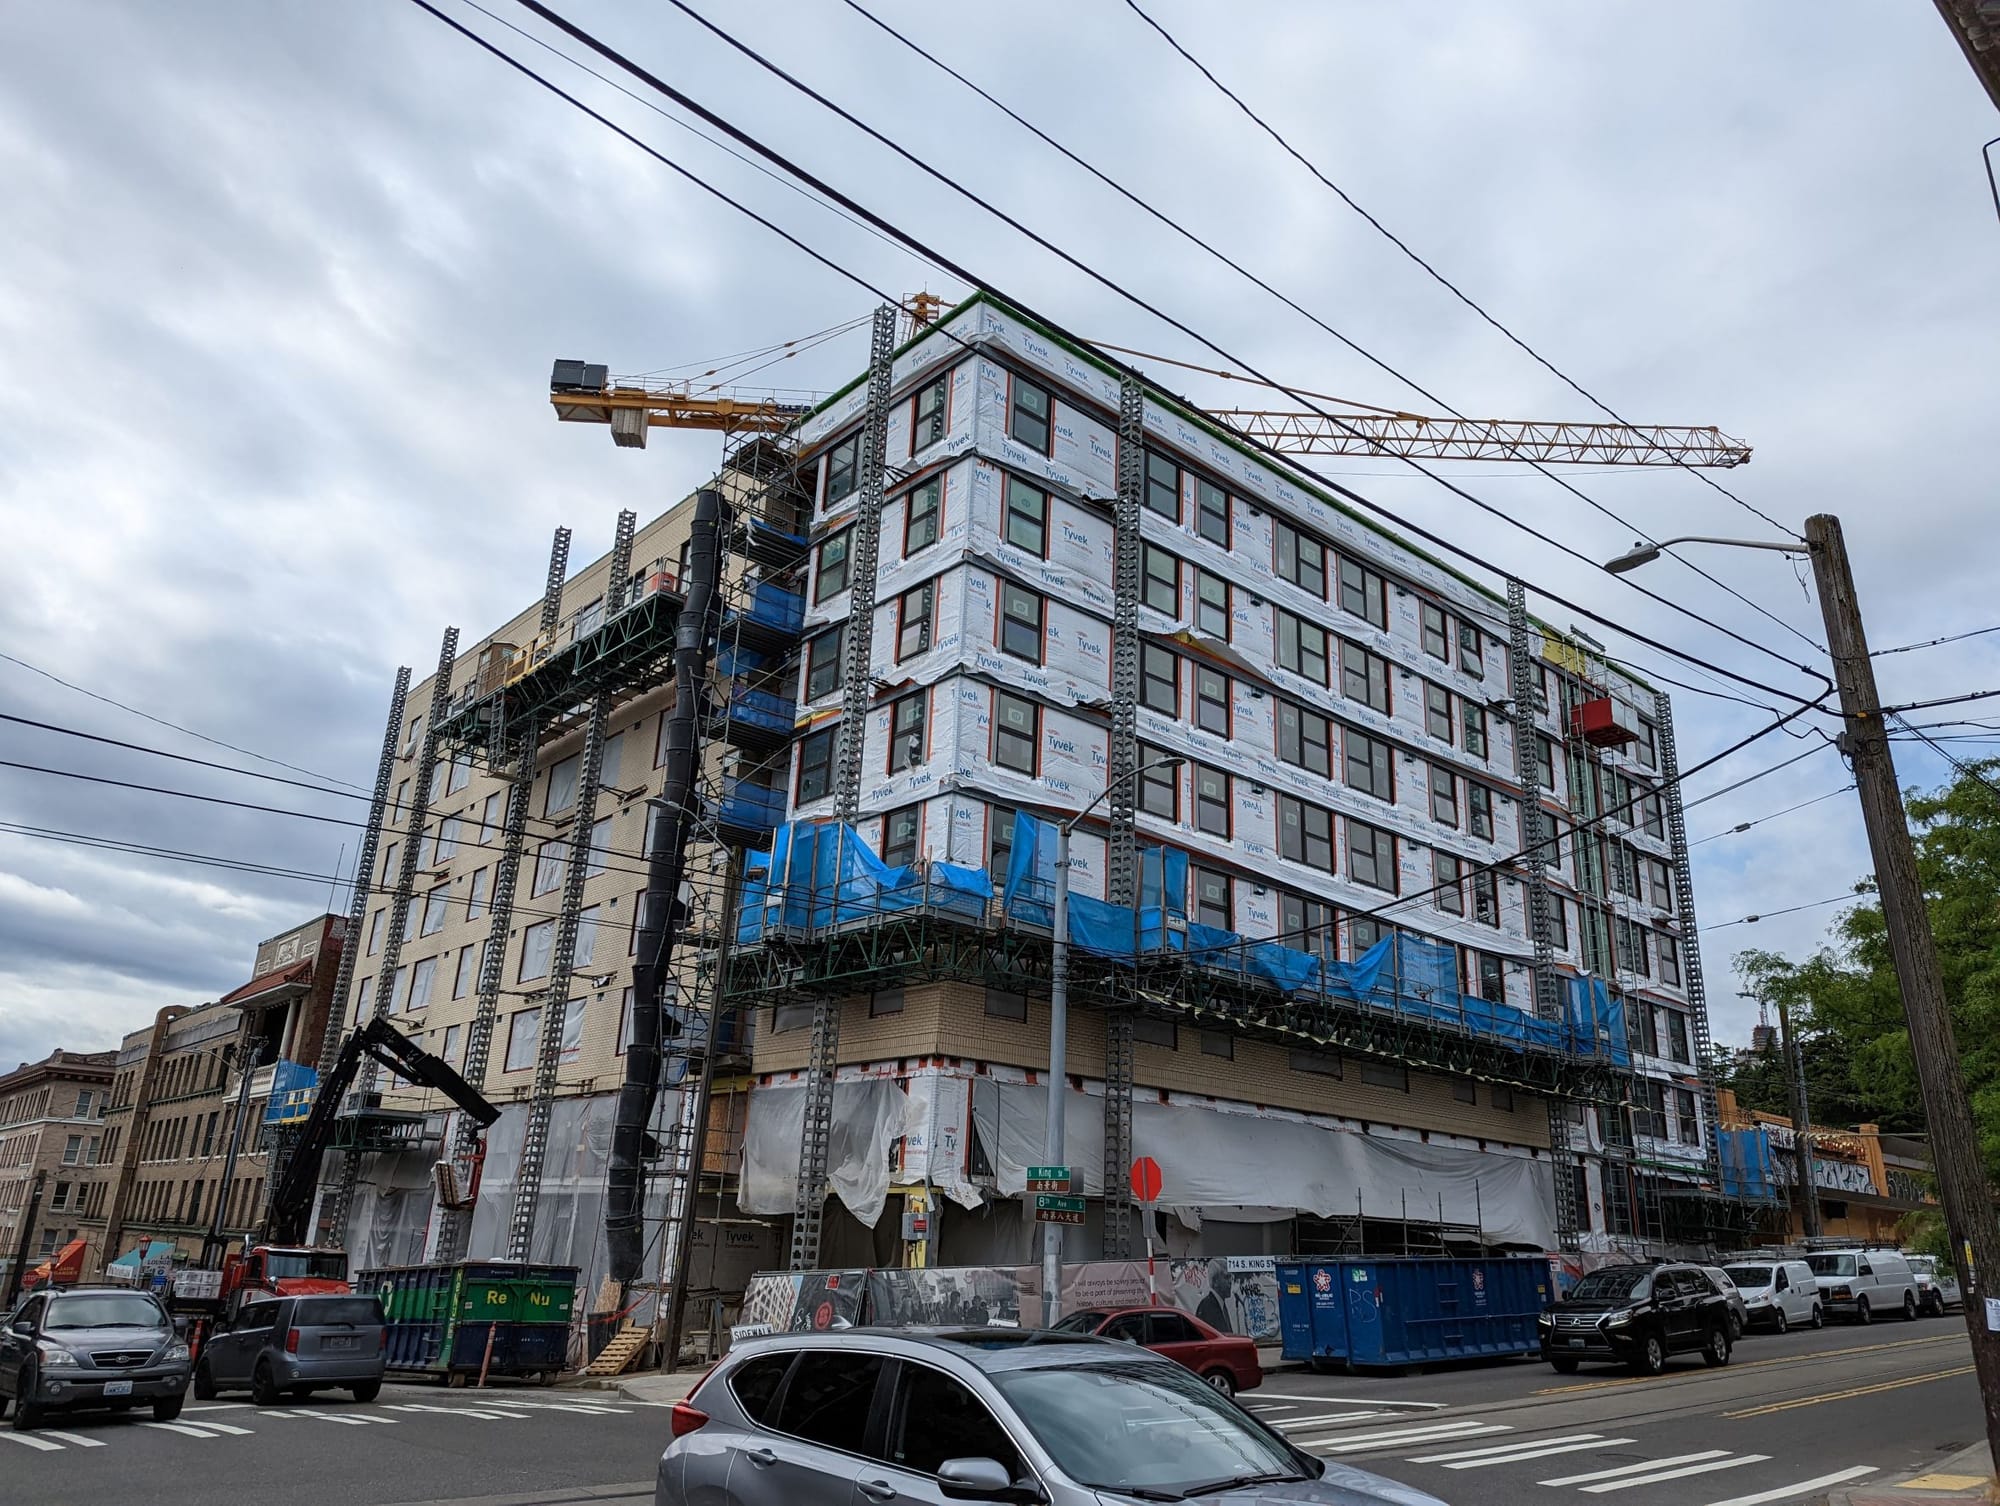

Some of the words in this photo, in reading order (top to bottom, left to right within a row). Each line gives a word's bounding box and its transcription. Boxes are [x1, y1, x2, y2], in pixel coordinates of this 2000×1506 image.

[1248, 907, 1269, 921] Tyvek
[1038, 1168, 1052, 1178] King
[1056, 1200, 1067, 1208] Ave
[725, 1230, 754, 1243] Tyvek
[1249, 1260, 1265, 1268] KING
[487, 1290, 508, 1304] Re
[530, 1292, 550, 1306] Nu
[1095, 1290, 1106, 1298] part
